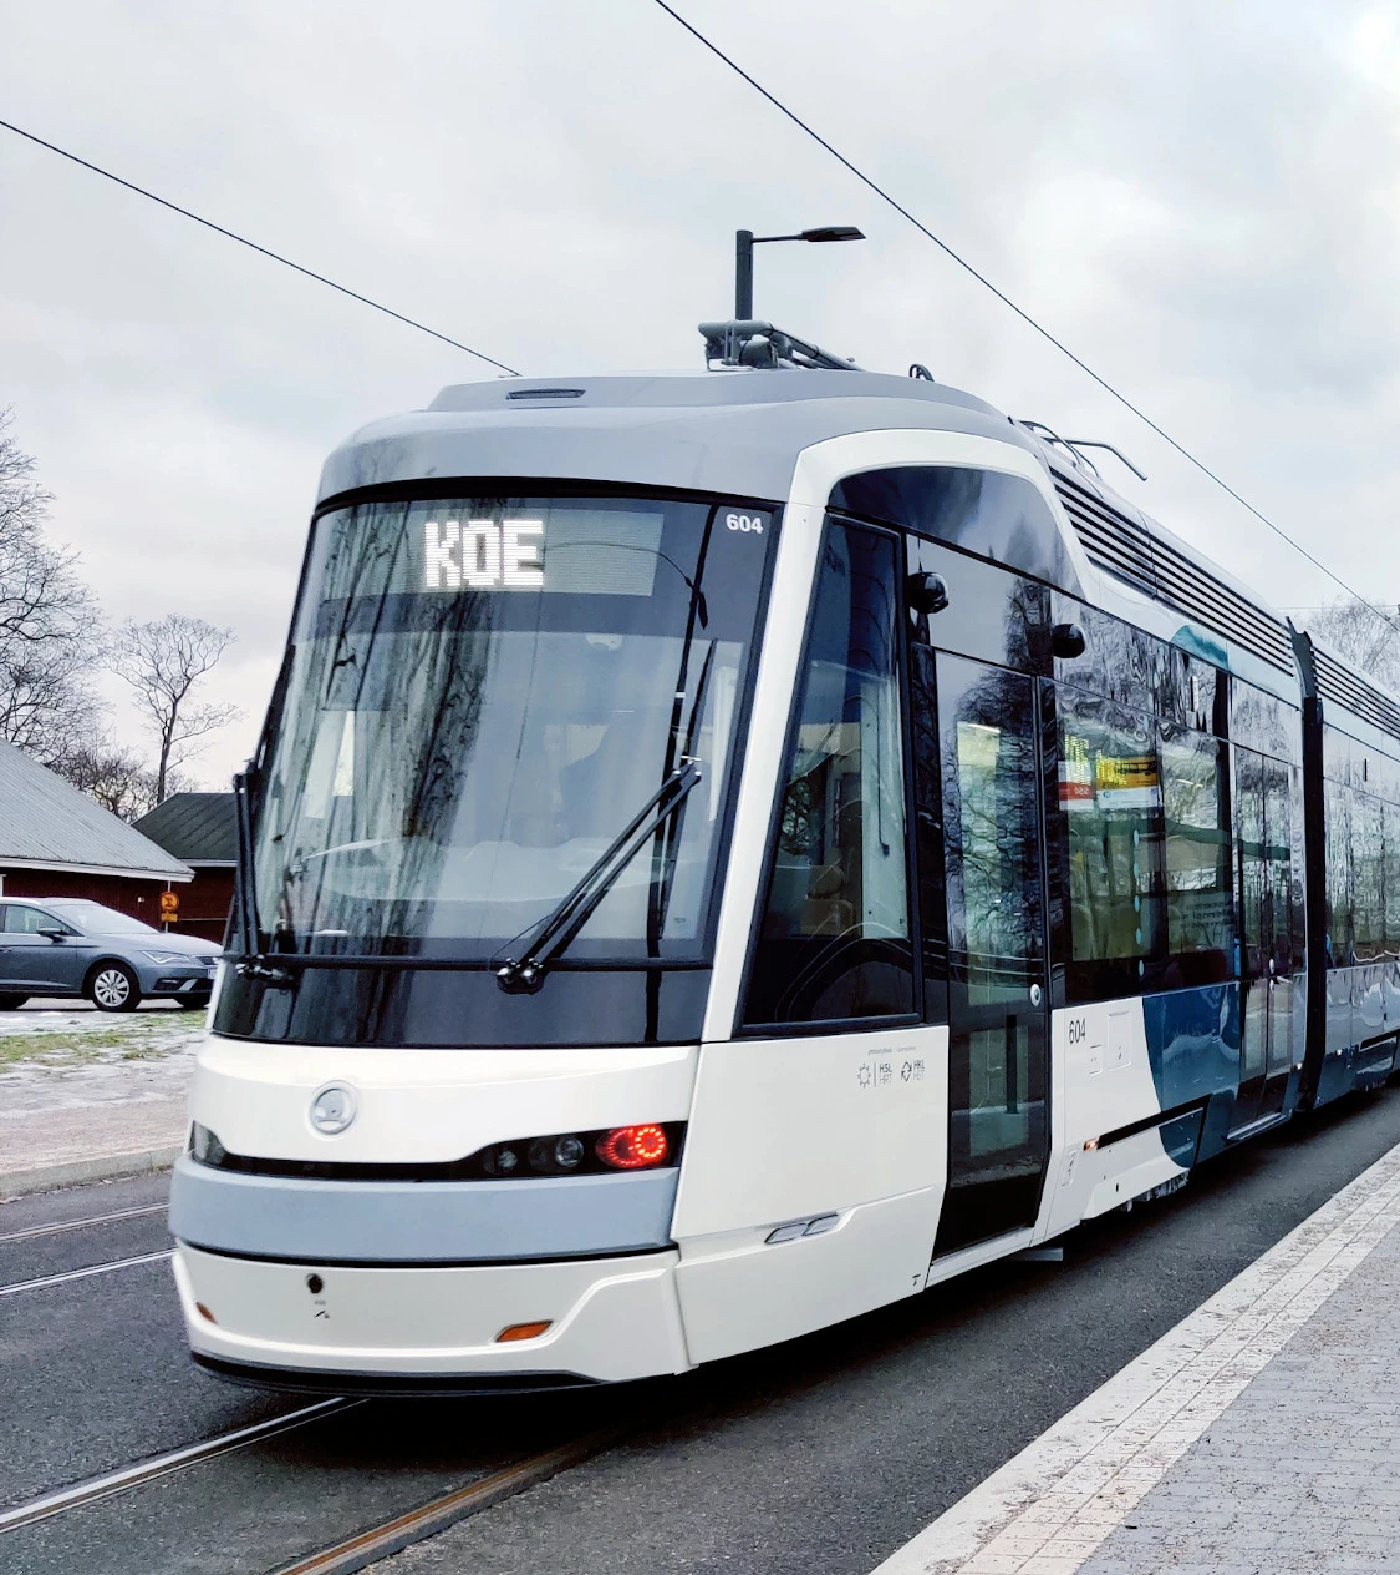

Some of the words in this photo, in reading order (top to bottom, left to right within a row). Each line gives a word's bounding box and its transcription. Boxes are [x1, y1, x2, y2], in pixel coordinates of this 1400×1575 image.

[726, 513, 764, 535] 604
[424, 520, 545, 587] KOE
[1069, 1018, 1086, 1045] 604
